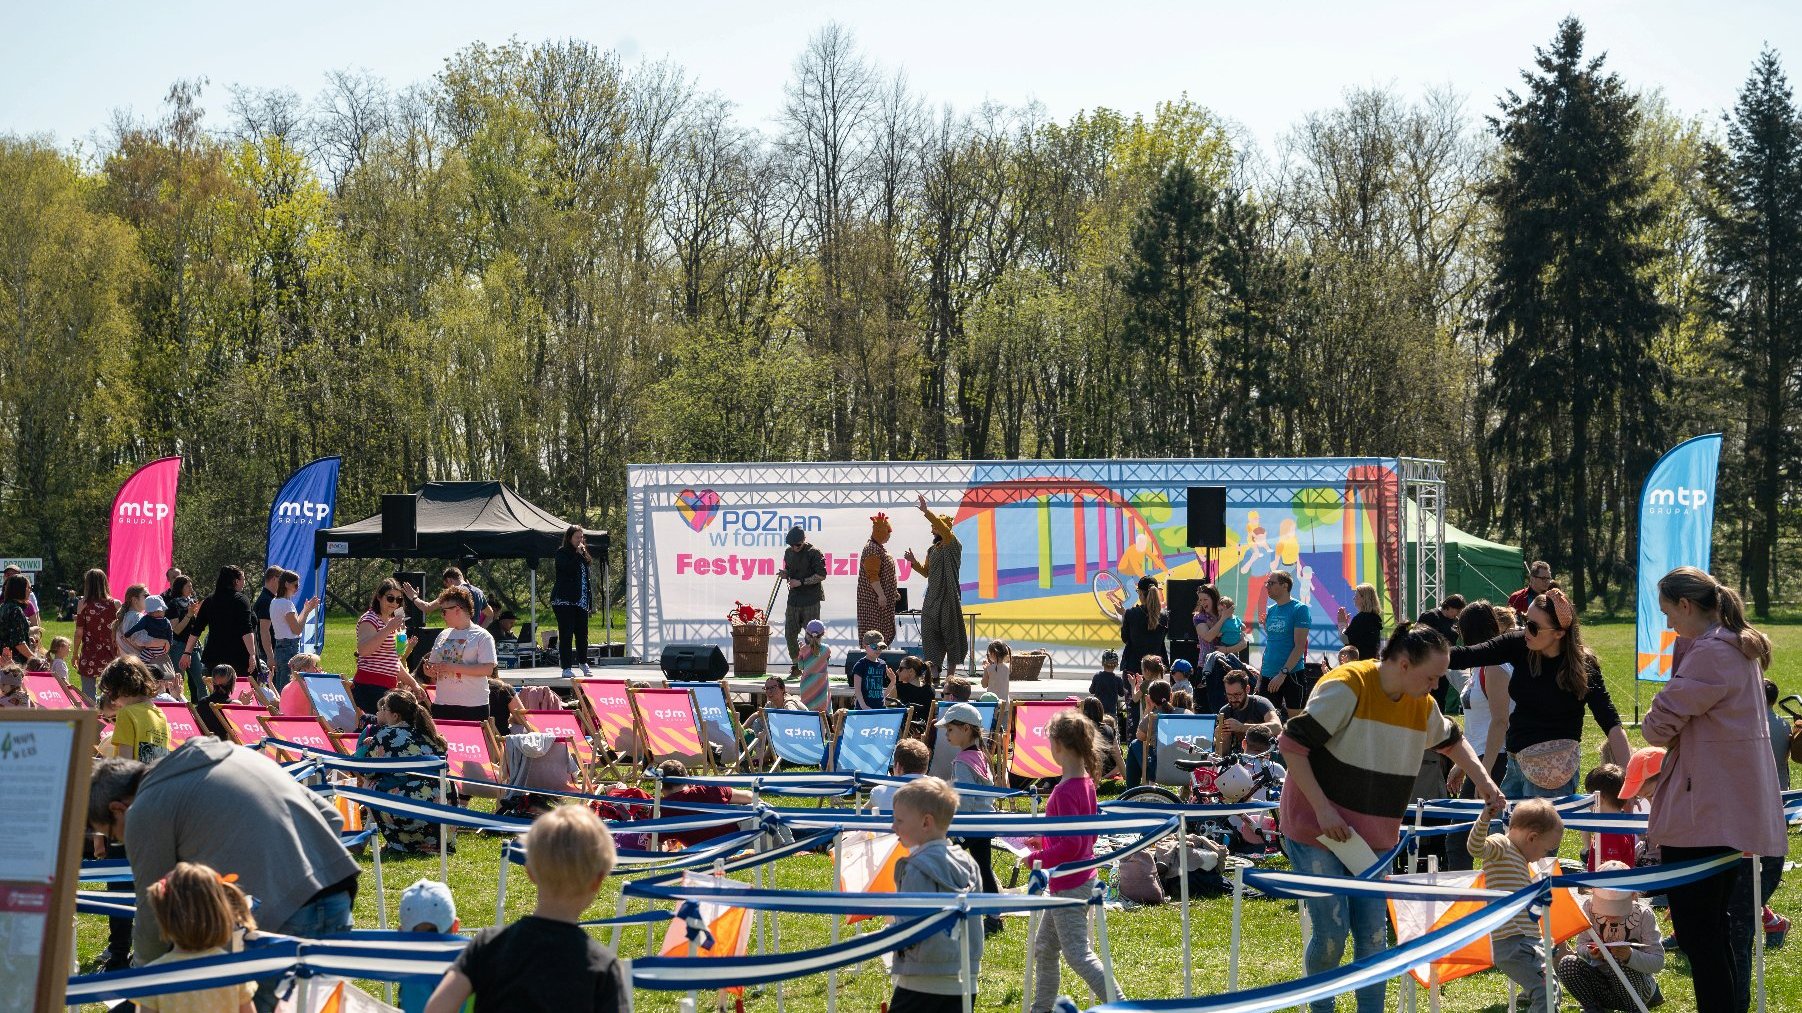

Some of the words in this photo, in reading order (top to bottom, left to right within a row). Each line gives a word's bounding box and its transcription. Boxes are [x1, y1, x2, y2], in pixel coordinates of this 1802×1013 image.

[1649, 486, 1708, 510] mtp
[118, 517, 153, 525] GRUPA
[119, 500, 169, 521] mtp
[278, 500, 330, 521] mtp
[278, 517, 313, 525] GRUPA
[722, 510, 822, 532] POZnan
[709, 532, 729, 547] w
[733, 528, 789, 547] formi
[676, 553, 776, 581] Festyn
